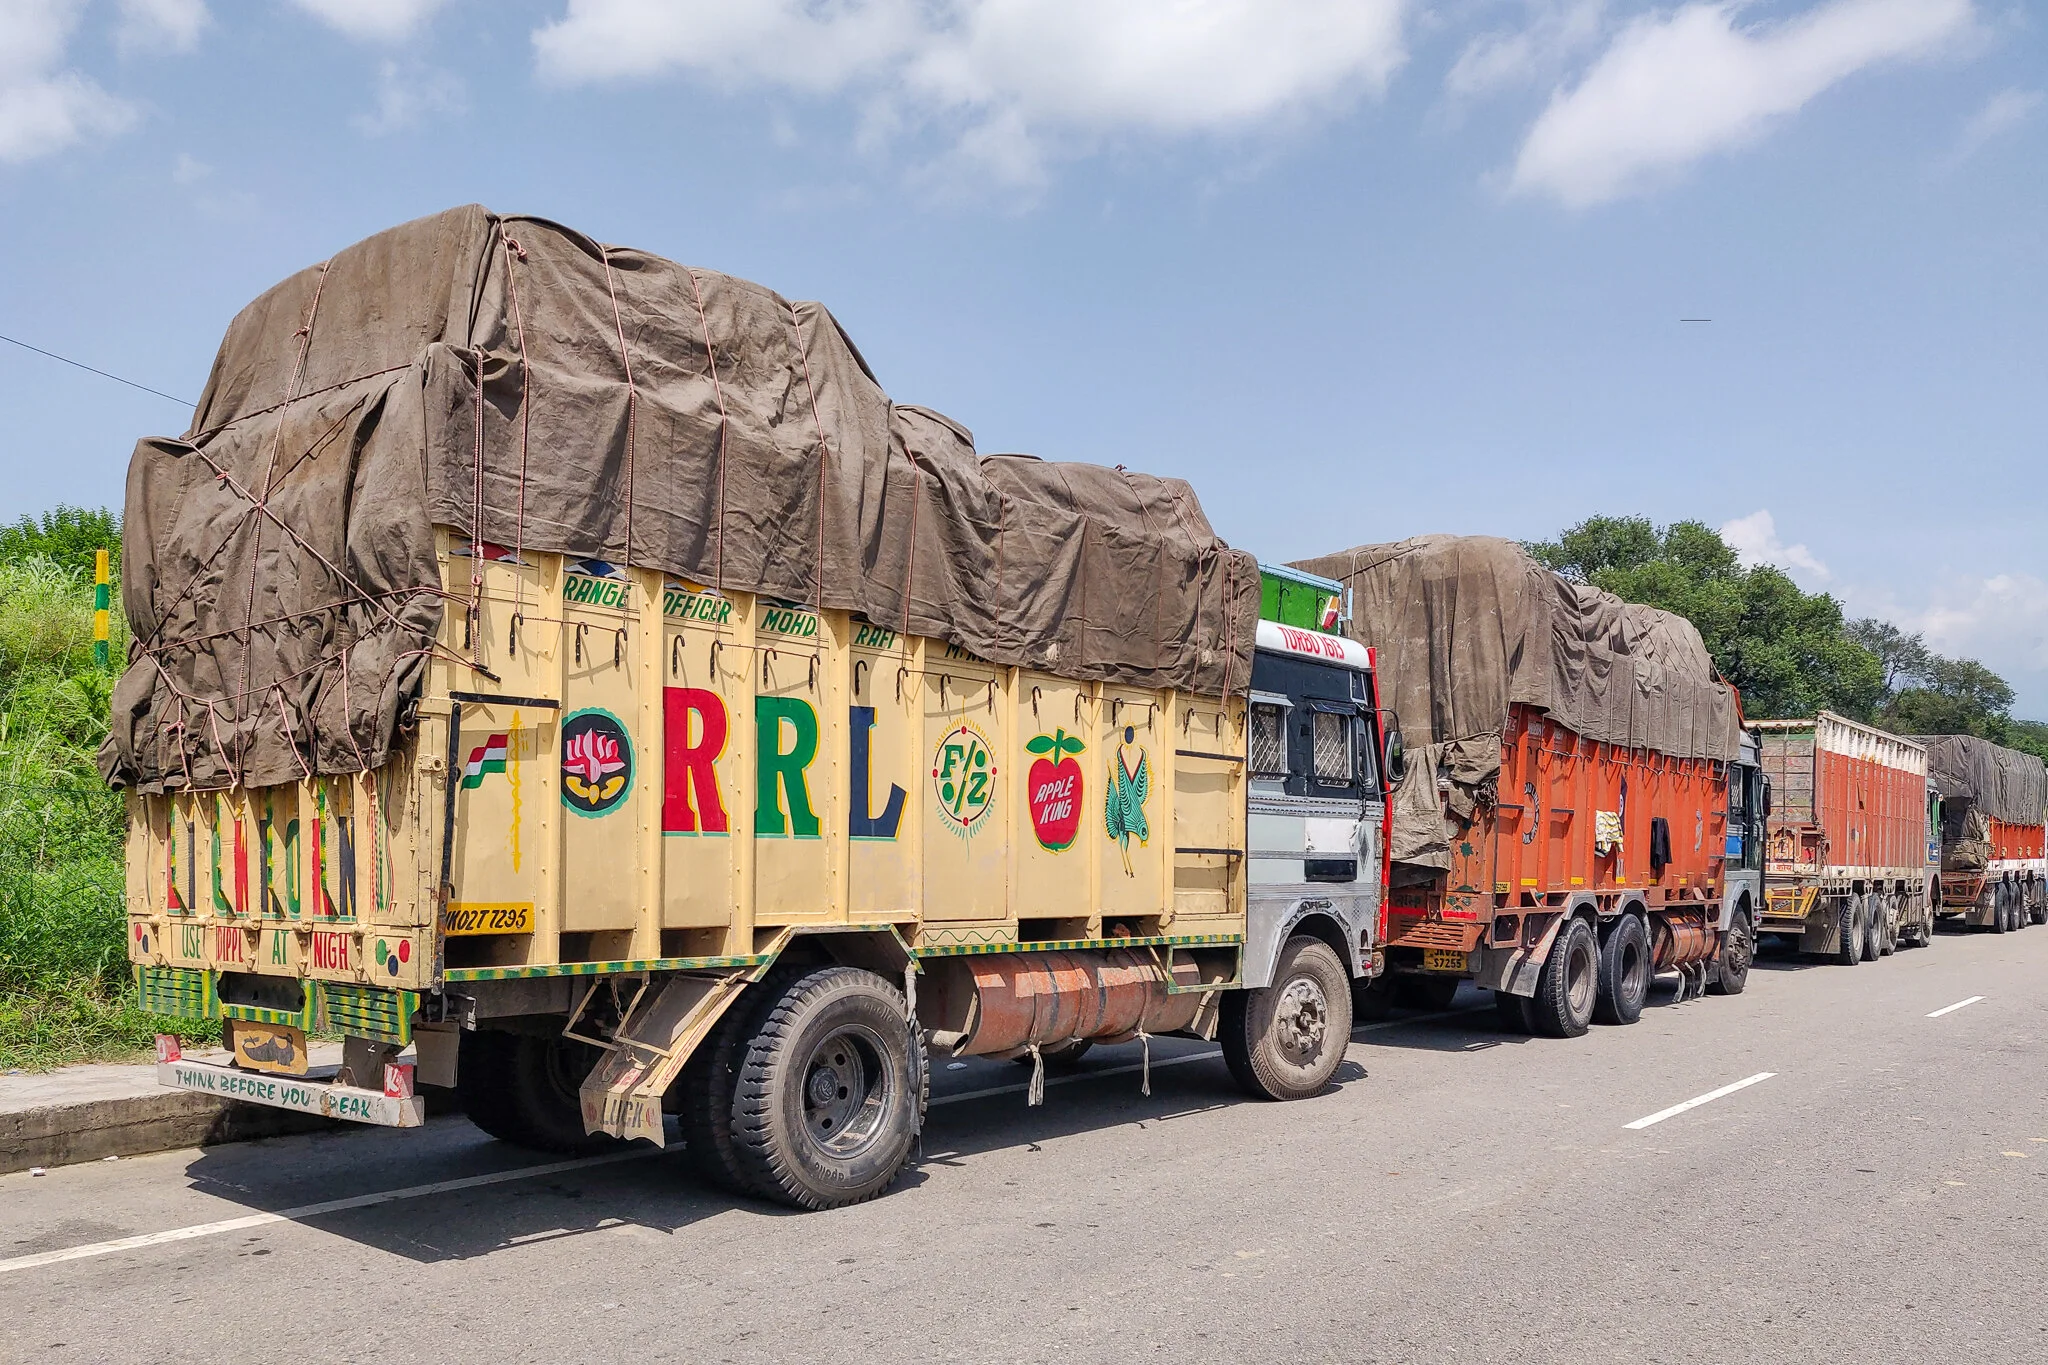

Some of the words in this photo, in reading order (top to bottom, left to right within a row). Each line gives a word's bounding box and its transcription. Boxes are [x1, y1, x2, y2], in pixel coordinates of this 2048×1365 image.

[563, 575, 631, 608] RANGE
[663, 592, 733, 624] OFFICER
[1277, 626, 1320, 654] TURBO
[1317, 635, 1345, 659] 1613
[1034, 775, 1075, 804] APPLE
[1039, 799, 1073, 824] KING
[181, 923, 201, 960] USE
[272, 929, 290, 965] AT
[175, 1069, 216, 1091] THINK
[220, 1077, 276, 1101] BEFORE
[281, 1085, 311, 1107] YOU
[815, 1160, 845, 1181] apollo
